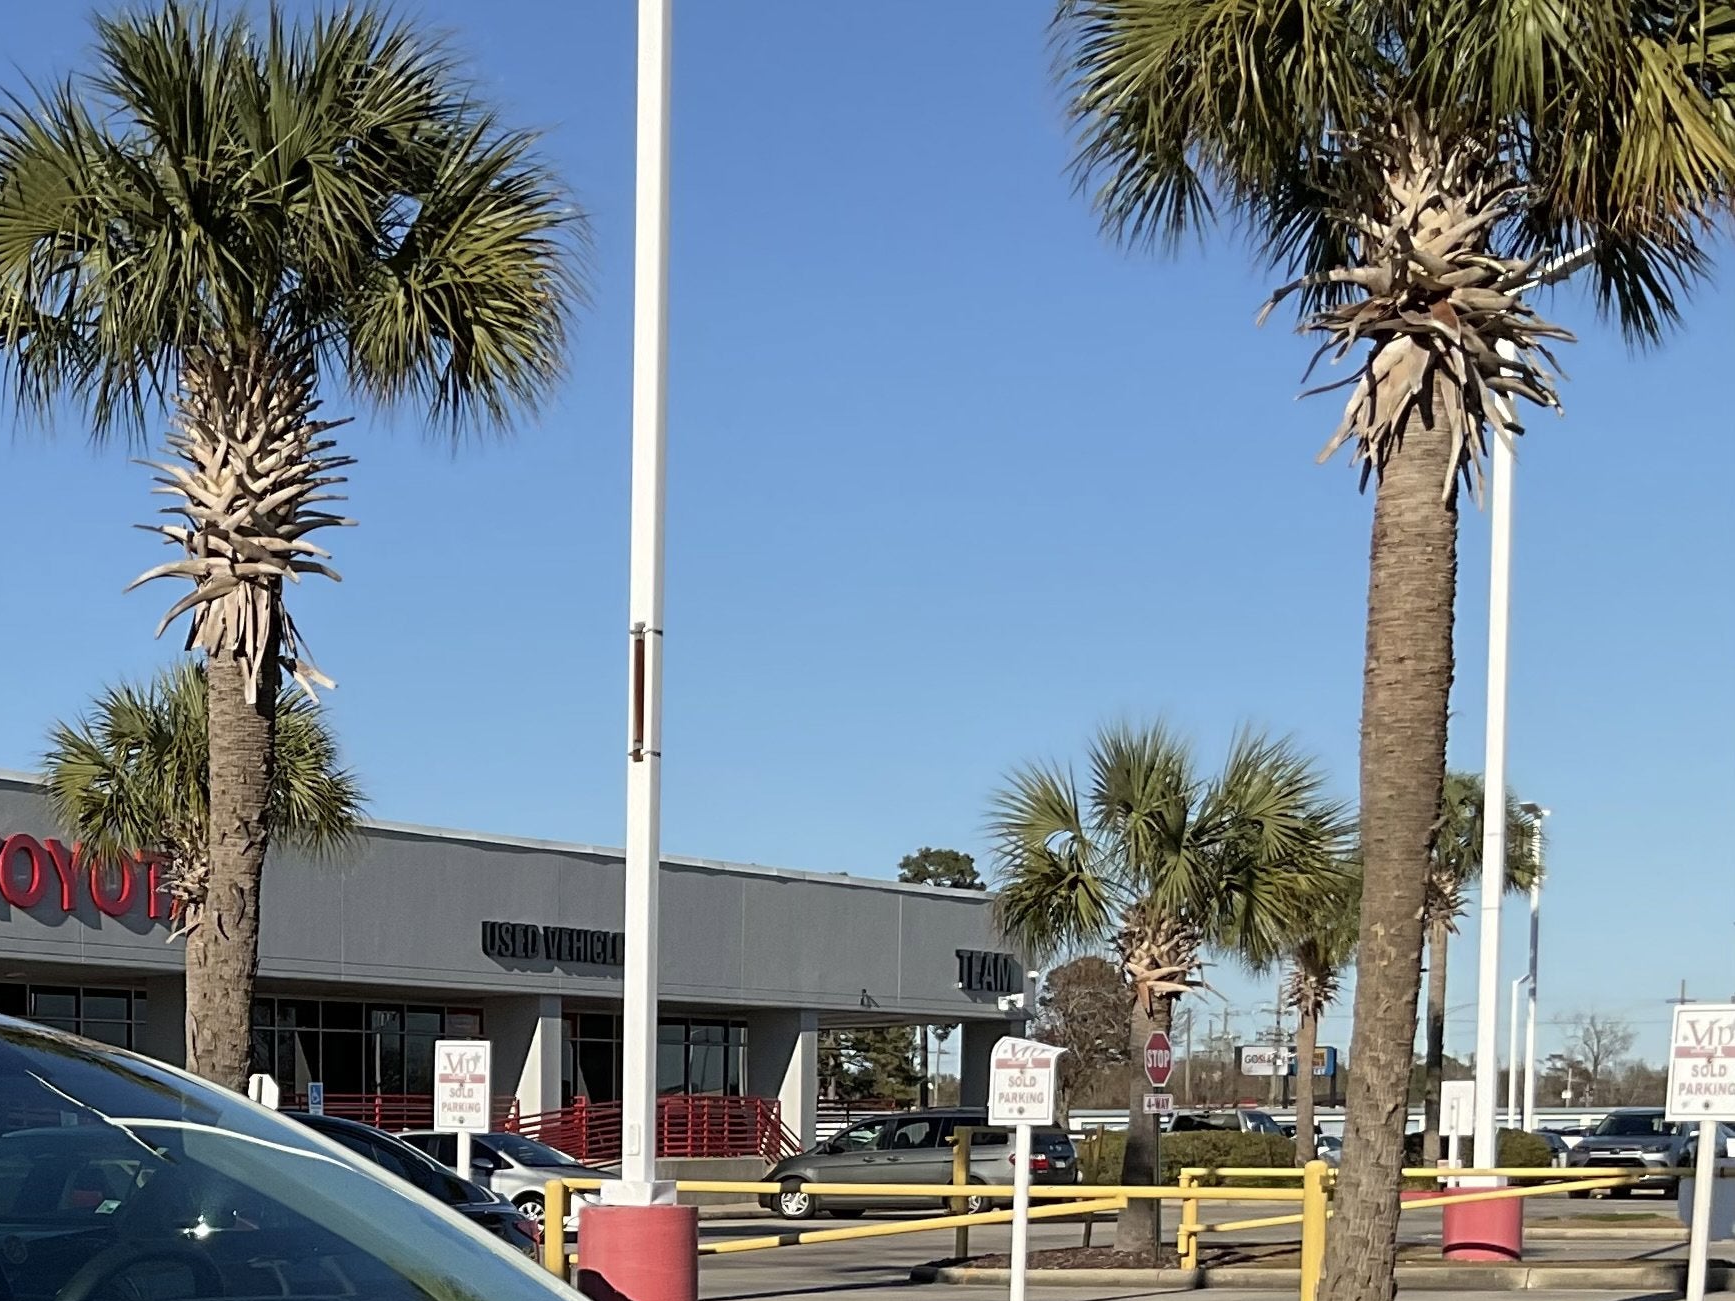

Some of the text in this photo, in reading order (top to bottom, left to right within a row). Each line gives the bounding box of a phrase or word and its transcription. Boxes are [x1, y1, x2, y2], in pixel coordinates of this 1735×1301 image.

[482, 921, 540, 959] USED
[955, 949, 1014, 993] TEAM
[1147, 1049, 1170, 1068] STOP
[1691, 1064, 1727, 1078] SOLD
[1008, 1075, 1037, 1088] SOLD
[449, 1087, 474, 1099] SOLD
[1678, 1082, 1735, 1096] PARKING
[998, 1092, 1045, 1104] PARKING
[1146, 1097, 1170, 1110] 4-WAY
[441, 1101, 482, 1114] PARKING
